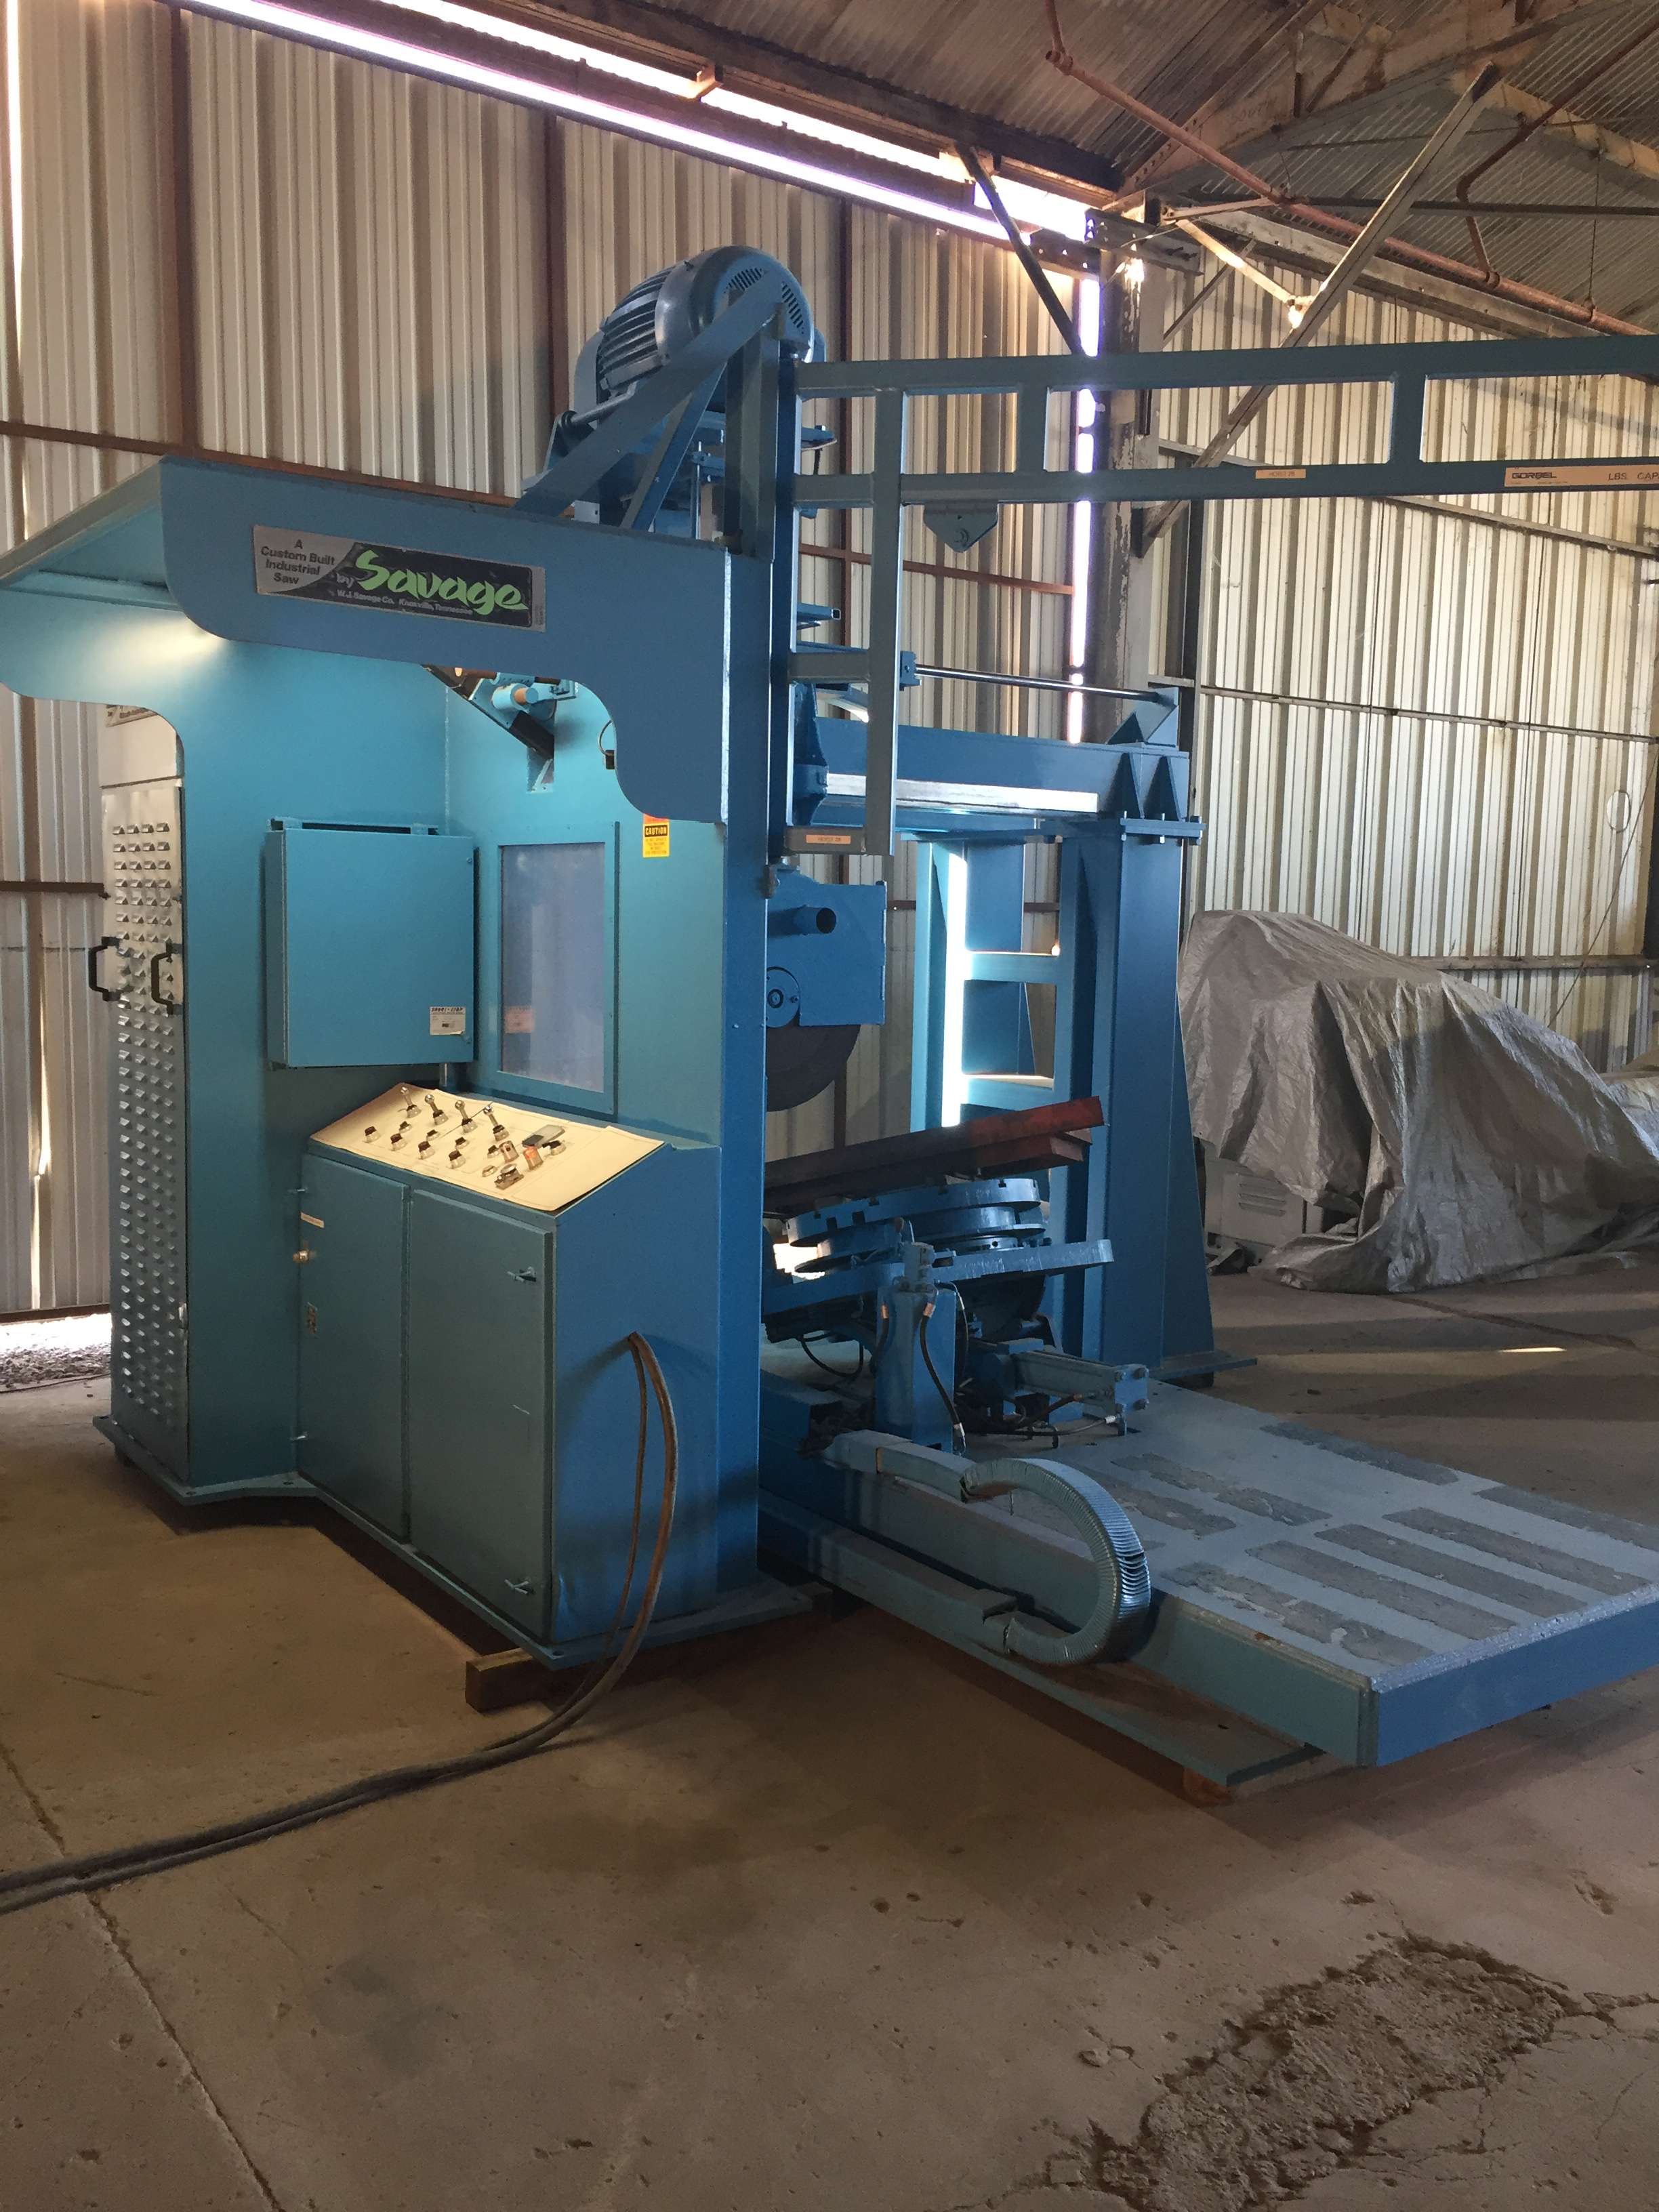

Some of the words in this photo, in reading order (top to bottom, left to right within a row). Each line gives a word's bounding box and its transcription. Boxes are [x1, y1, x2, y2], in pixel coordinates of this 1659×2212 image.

[1512, 472, 1557, 480] GORBEL
[294, 539, 302, 549] A
[261, 546, 306, 561] Custom
[310, 552, 335, 565] Built
[266, 558, 321, 575] Industrial
[274, 572, 299, 584] Saw
[337, 573, 354, 588] by
[355, 550, 529, 615] Savage
[645, 827, 667, 836] CAUTION
